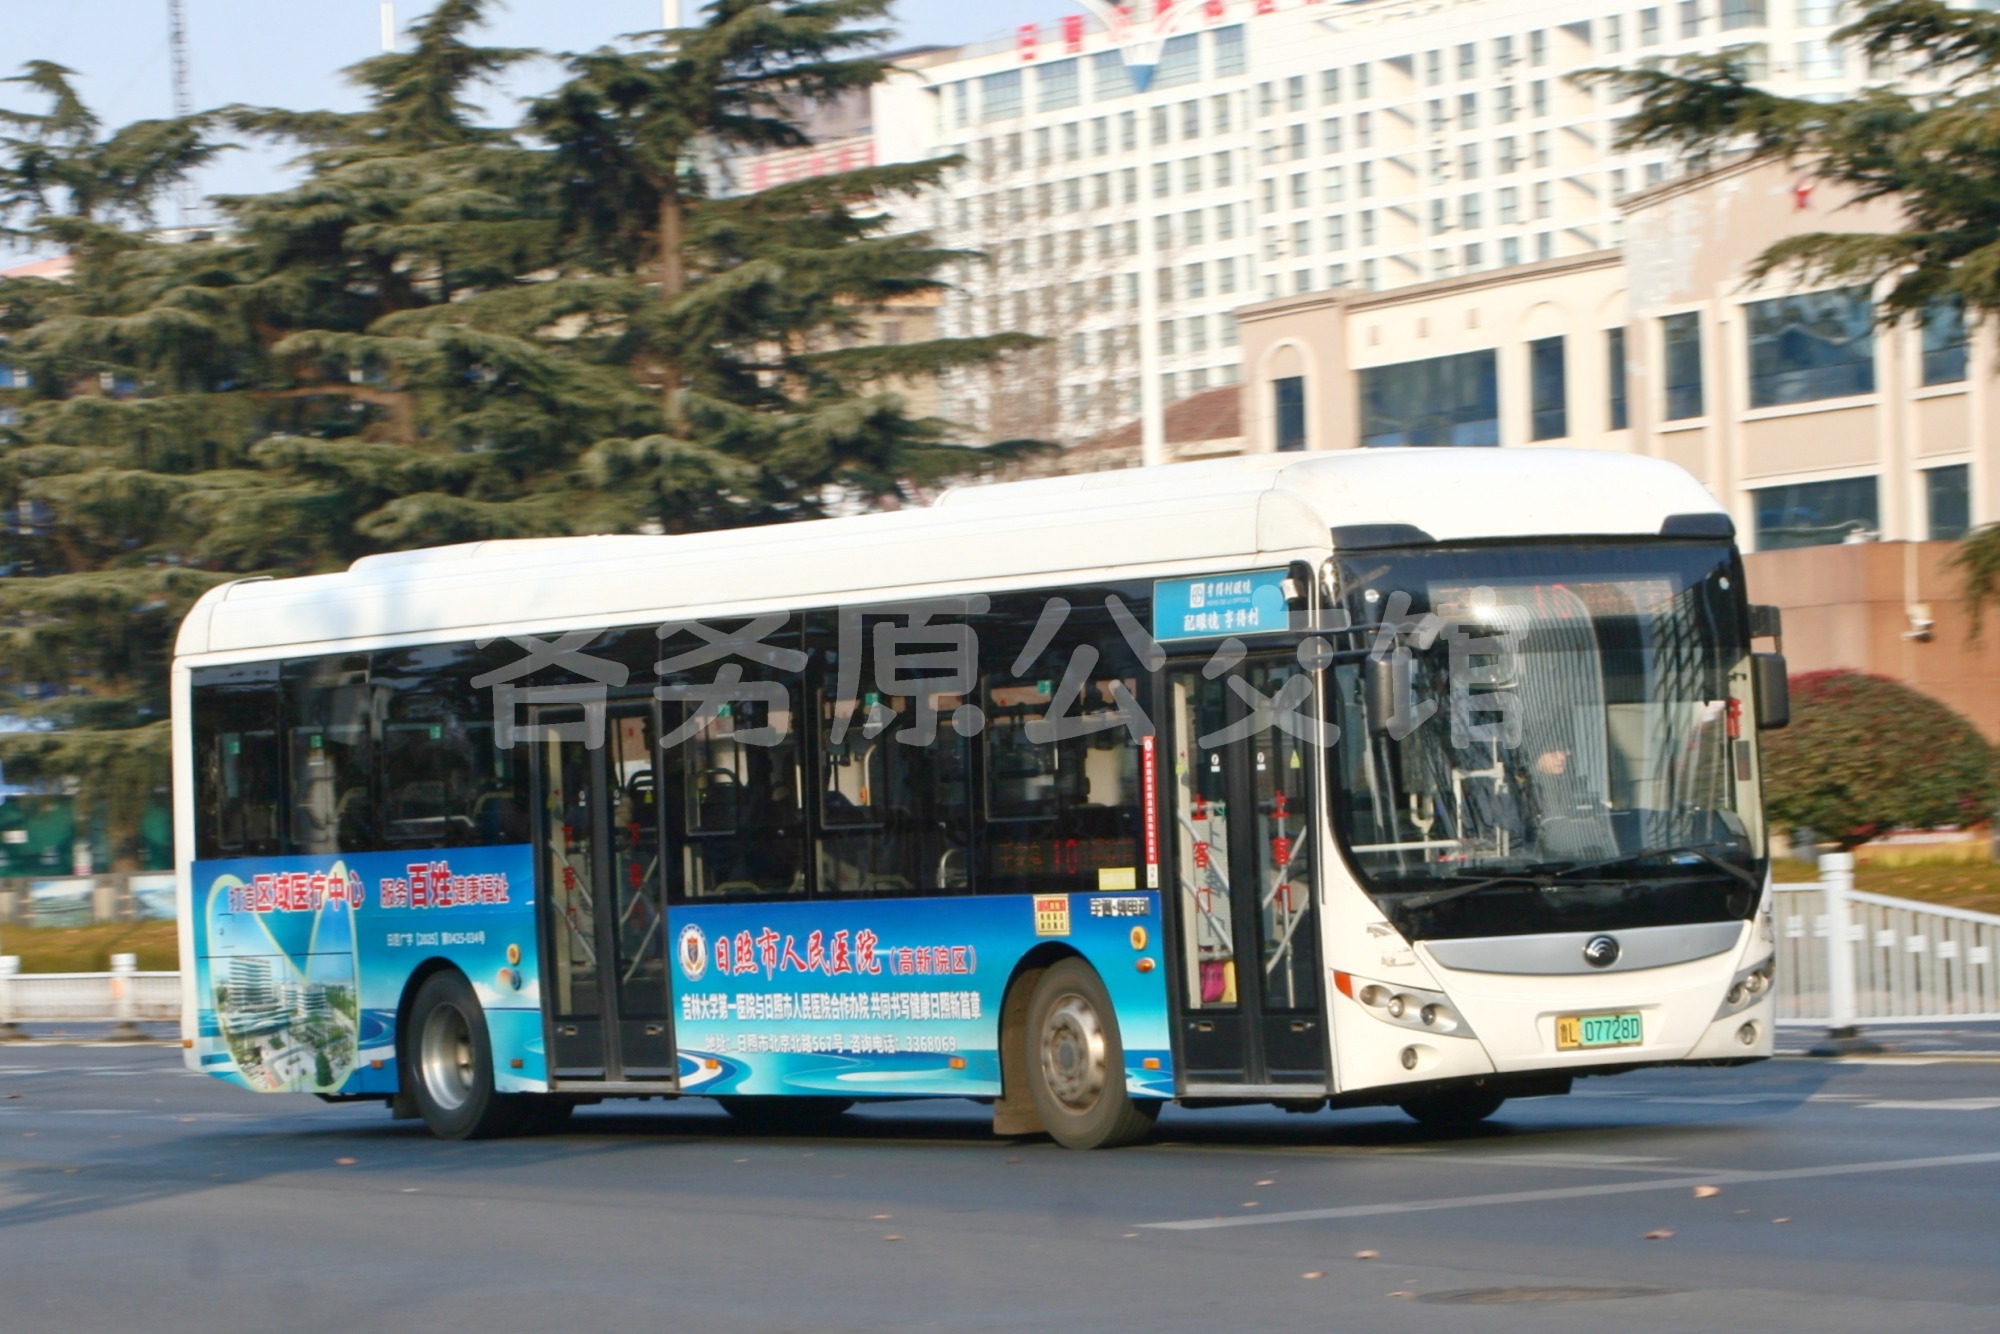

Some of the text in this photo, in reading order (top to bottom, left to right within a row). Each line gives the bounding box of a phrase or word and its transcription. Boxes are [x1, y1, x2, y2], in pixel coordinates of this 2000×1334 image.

[1053, 838, 1080, 876] 10
[229, 869, 365, 913] 打造区域医疗中心
[380, 860, 510, 909] 服务百姓健康福祉
[714, 926, 882, 981] 日照市人民医院
